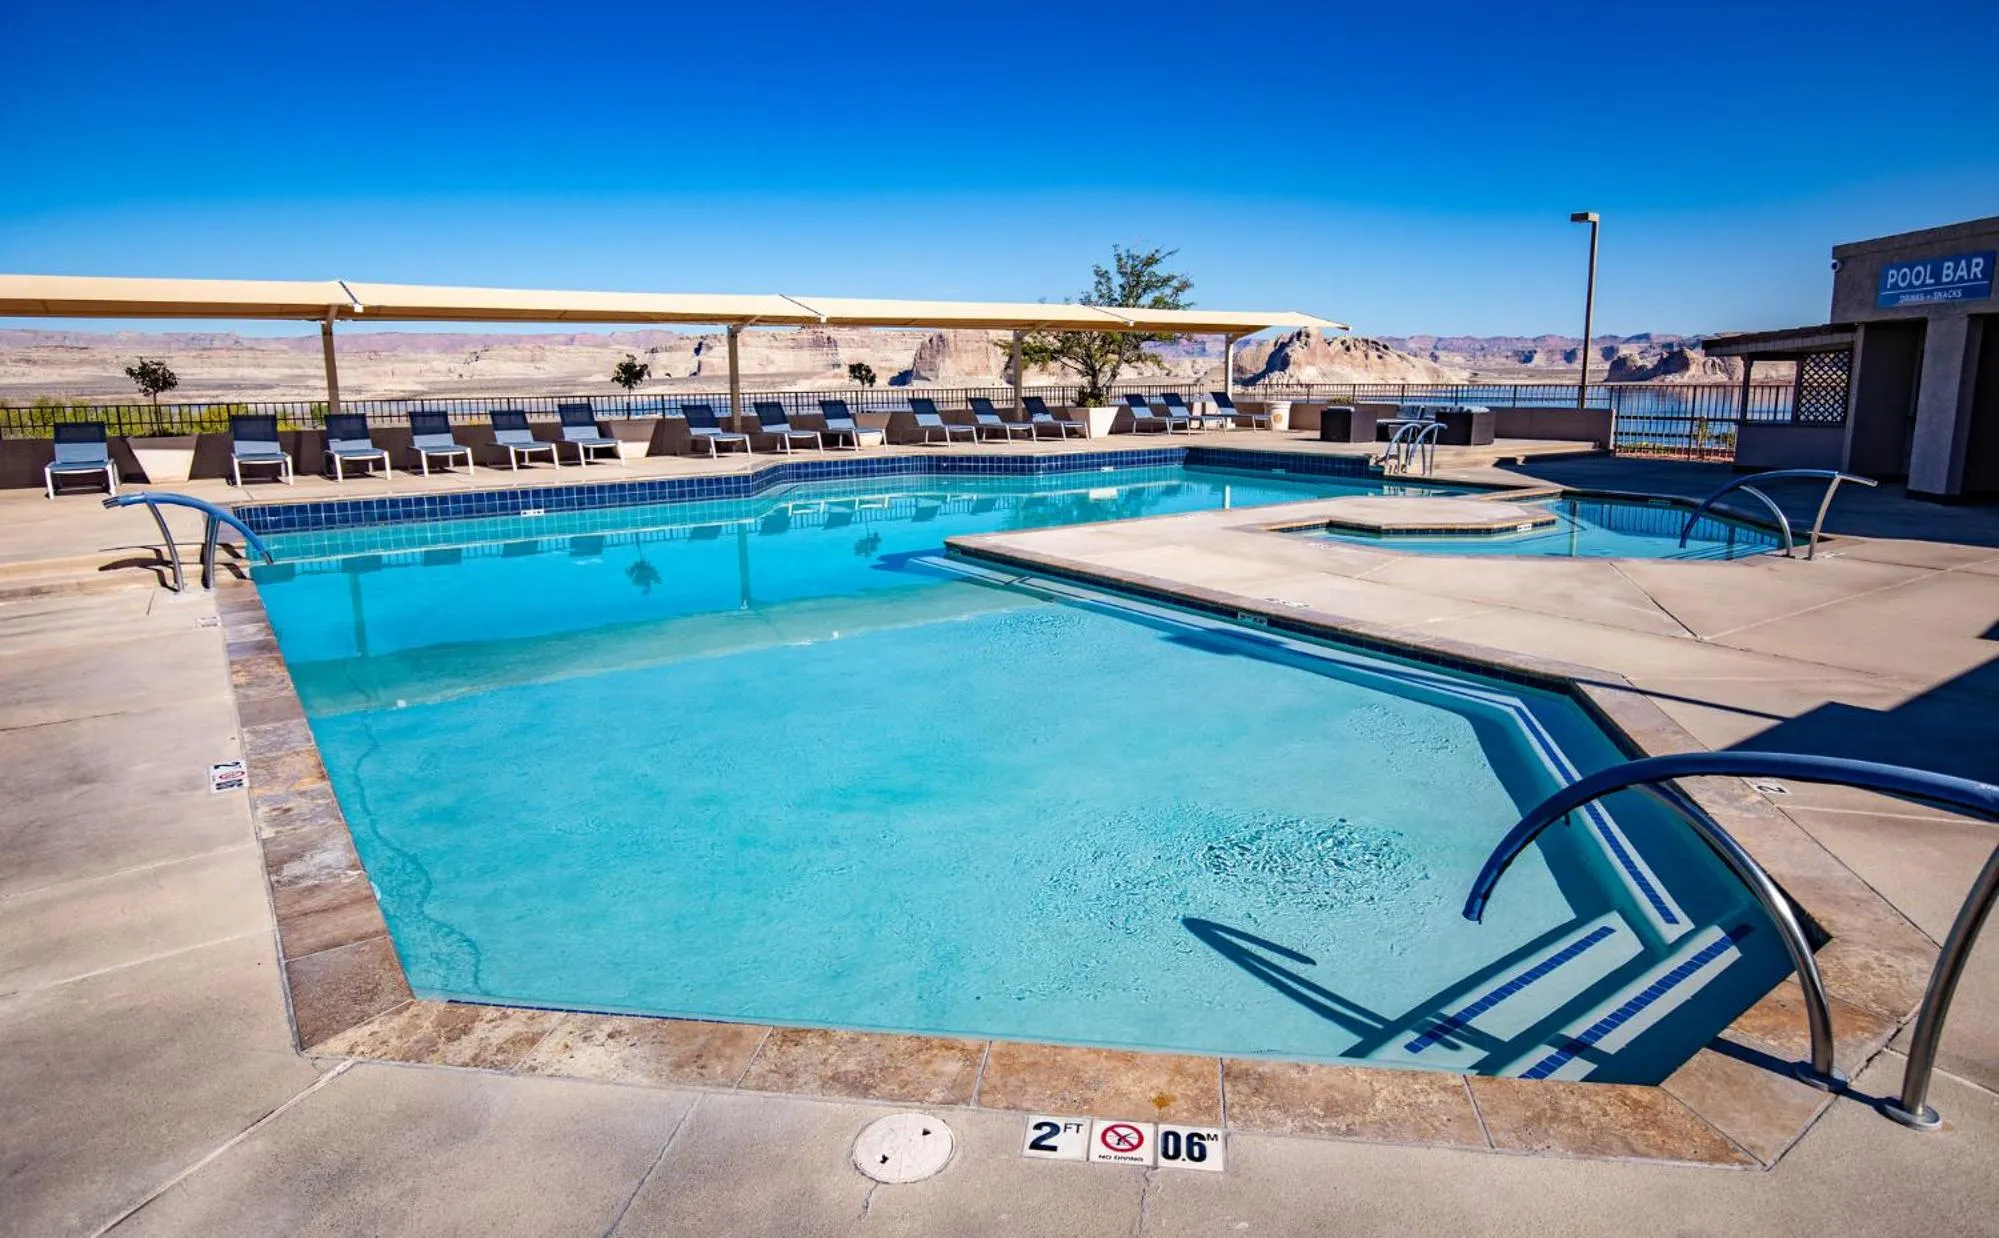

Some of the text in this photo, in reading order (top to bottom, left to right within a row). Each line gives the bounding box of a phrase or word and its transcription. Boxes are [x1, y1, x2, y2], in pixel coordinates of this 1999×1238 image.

[1886, 257, 1984, 289] POOL BAR
[1933, 289, 1962, 301] SNACKS
[1028, 1121, 1084, 1152] 2 FT
[1113, 1155, 1144, 1163] DIVING
